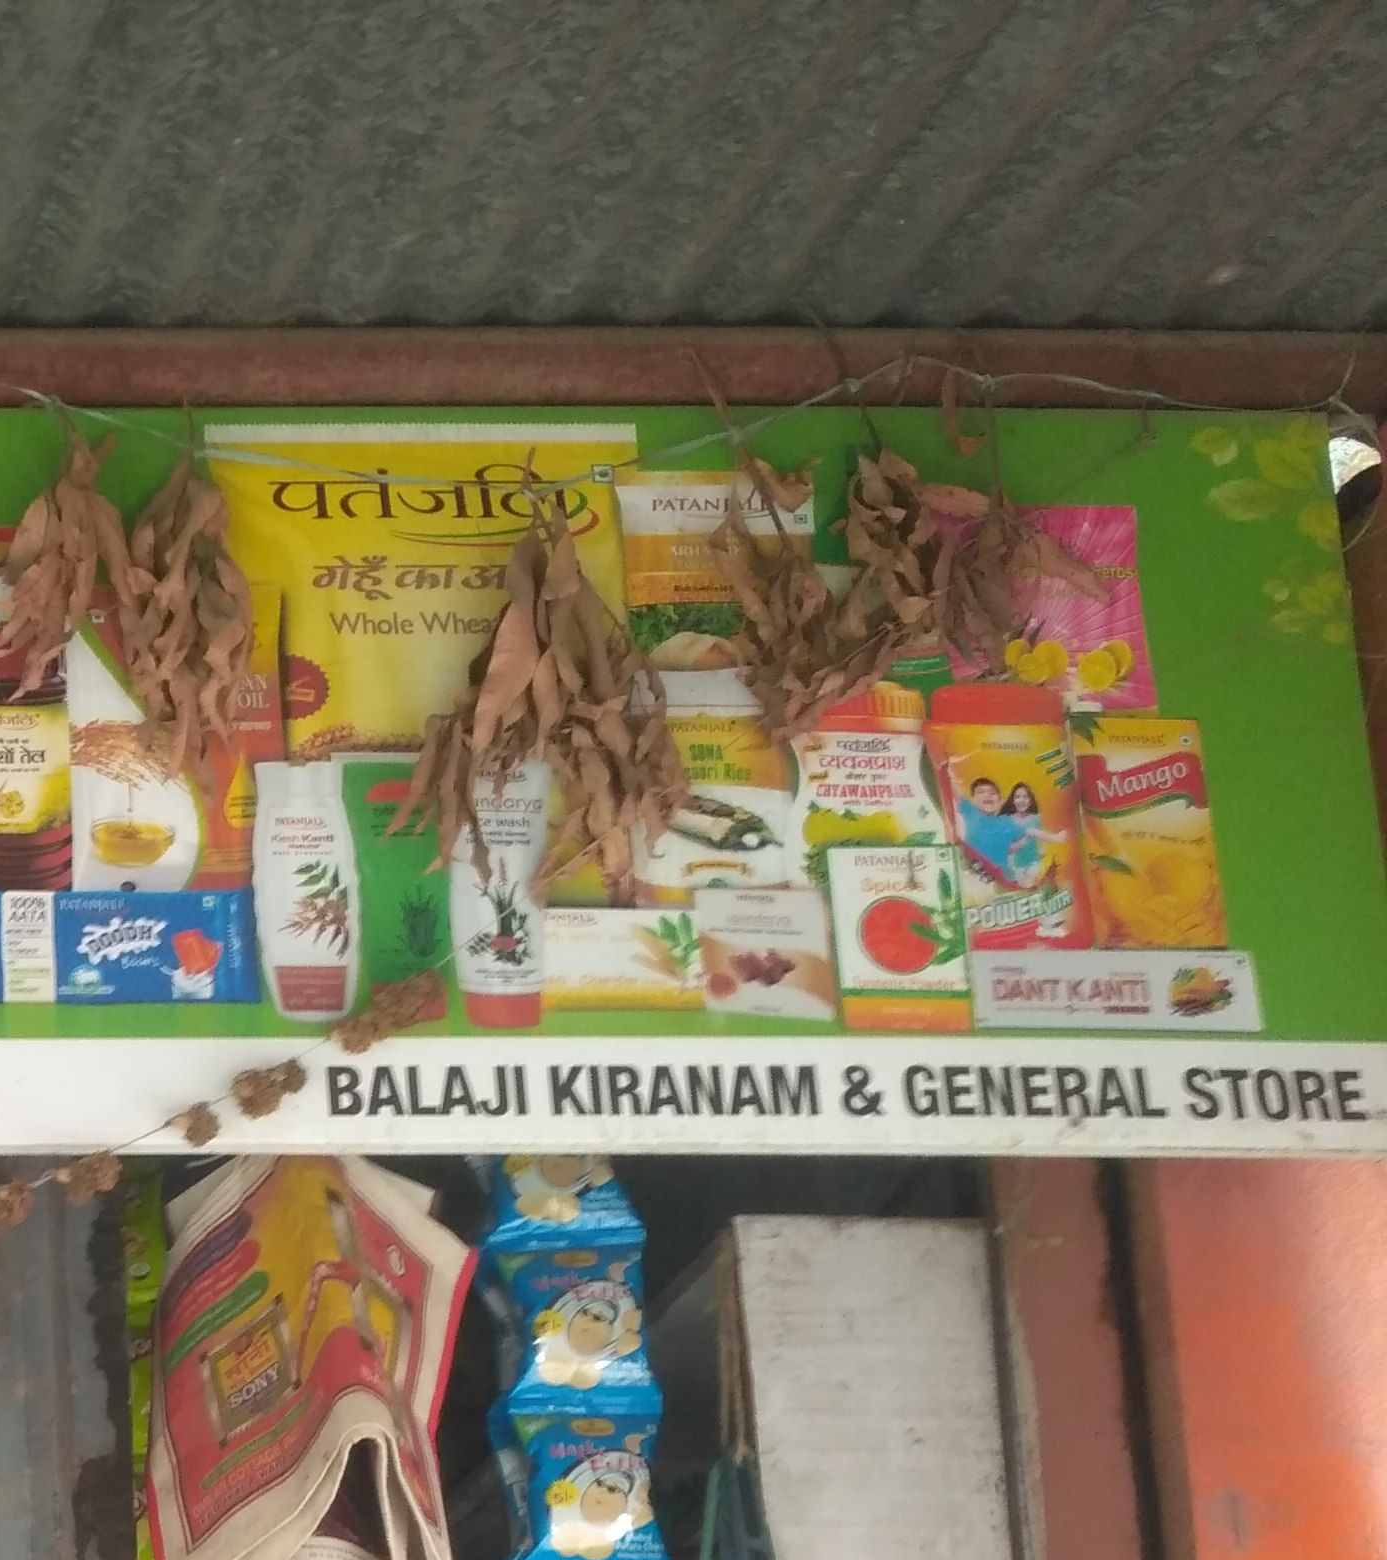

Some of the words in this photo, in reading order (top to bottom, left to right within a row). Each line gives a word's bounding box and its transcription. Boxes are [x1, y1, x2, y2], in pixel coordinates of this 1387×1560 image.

[651, 498, 772, 514] PATANJLI
[395, 564, 459, 590] का
[328, 611, 414, 635] Whole
[419, 611, 495, 635] Whea
[1096, 761, 1187, 802] Mango
[326, 1064, 527, 1118] BALAJI
[547, 1064, 822, 1118] KIRANAM
[841, 1066, 883, 1118] &
[901, 1065, 1165, 1119] GENERAL
[1185, 1067, 1366, 1121] STORE
